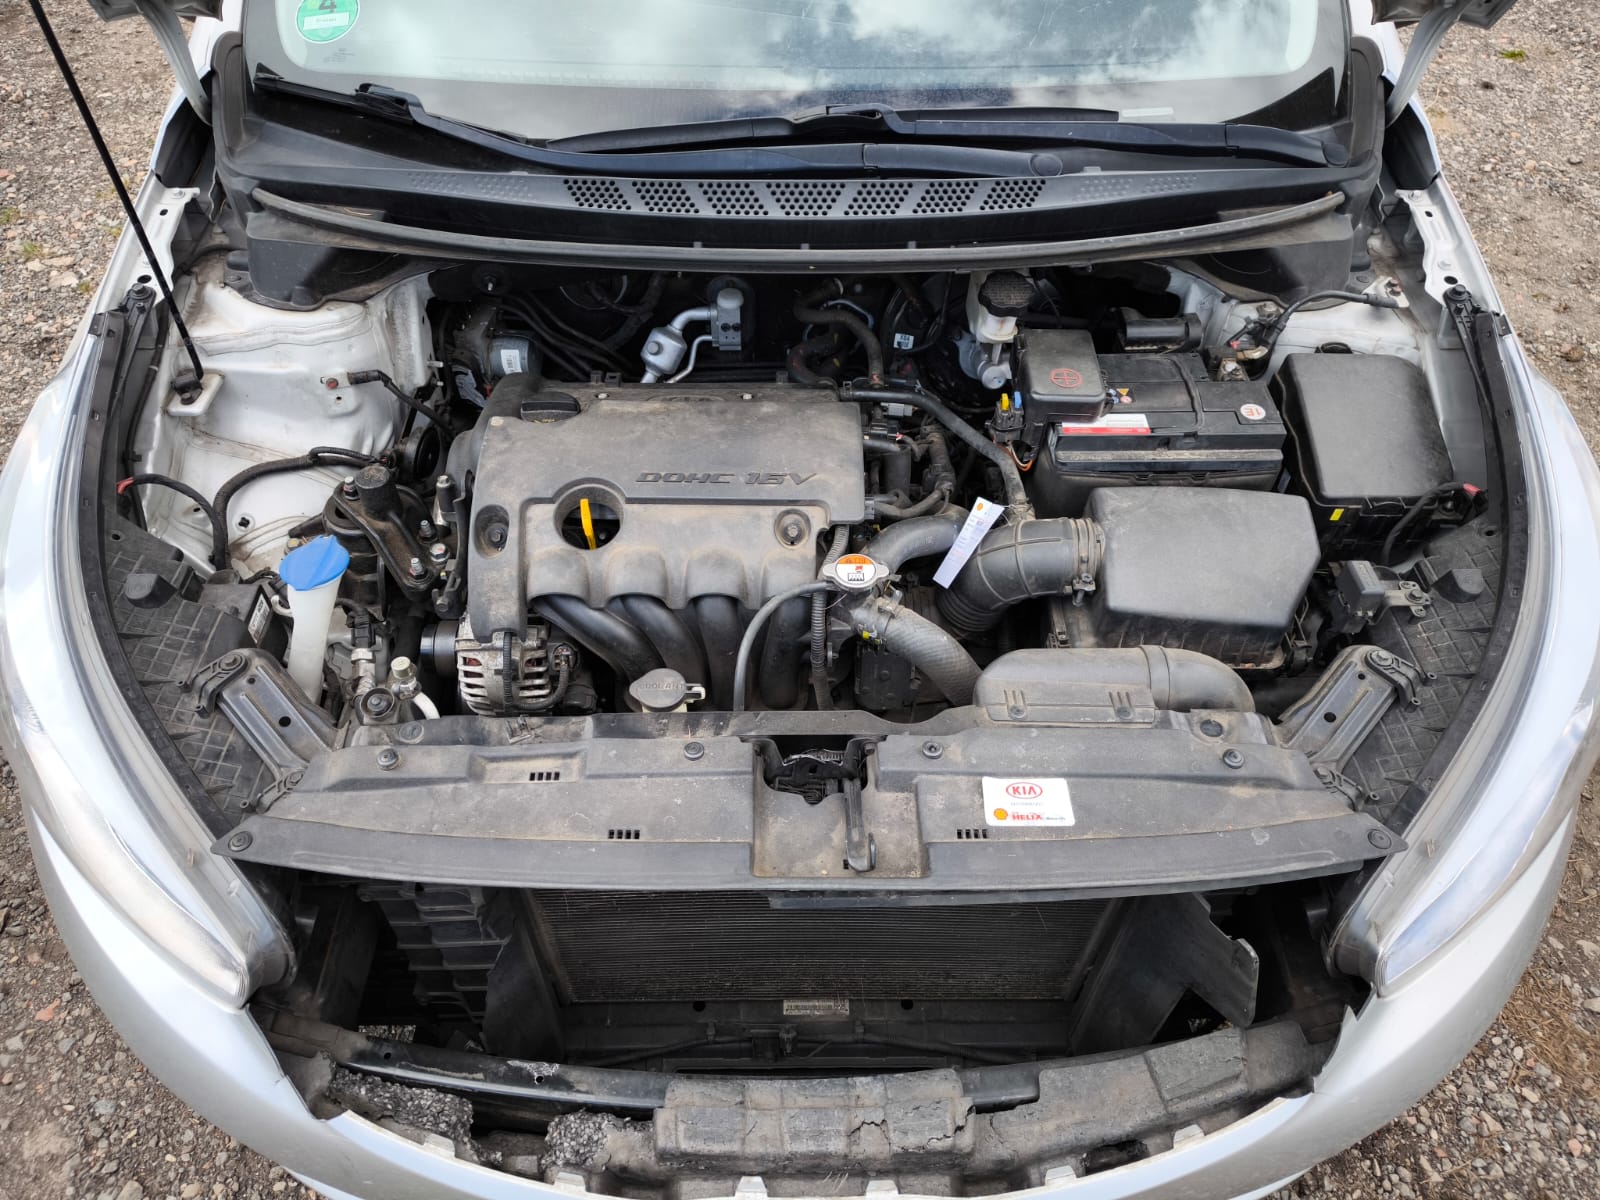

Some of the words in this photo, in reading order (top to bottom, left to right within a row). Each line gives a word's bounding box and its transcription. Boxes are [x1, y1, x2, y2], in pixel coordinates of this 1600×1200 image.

[635, 472, 735, 484] DOHC
[745, 472, 817, 486] 16V
[1011, 785, 1038, 796] KIA
